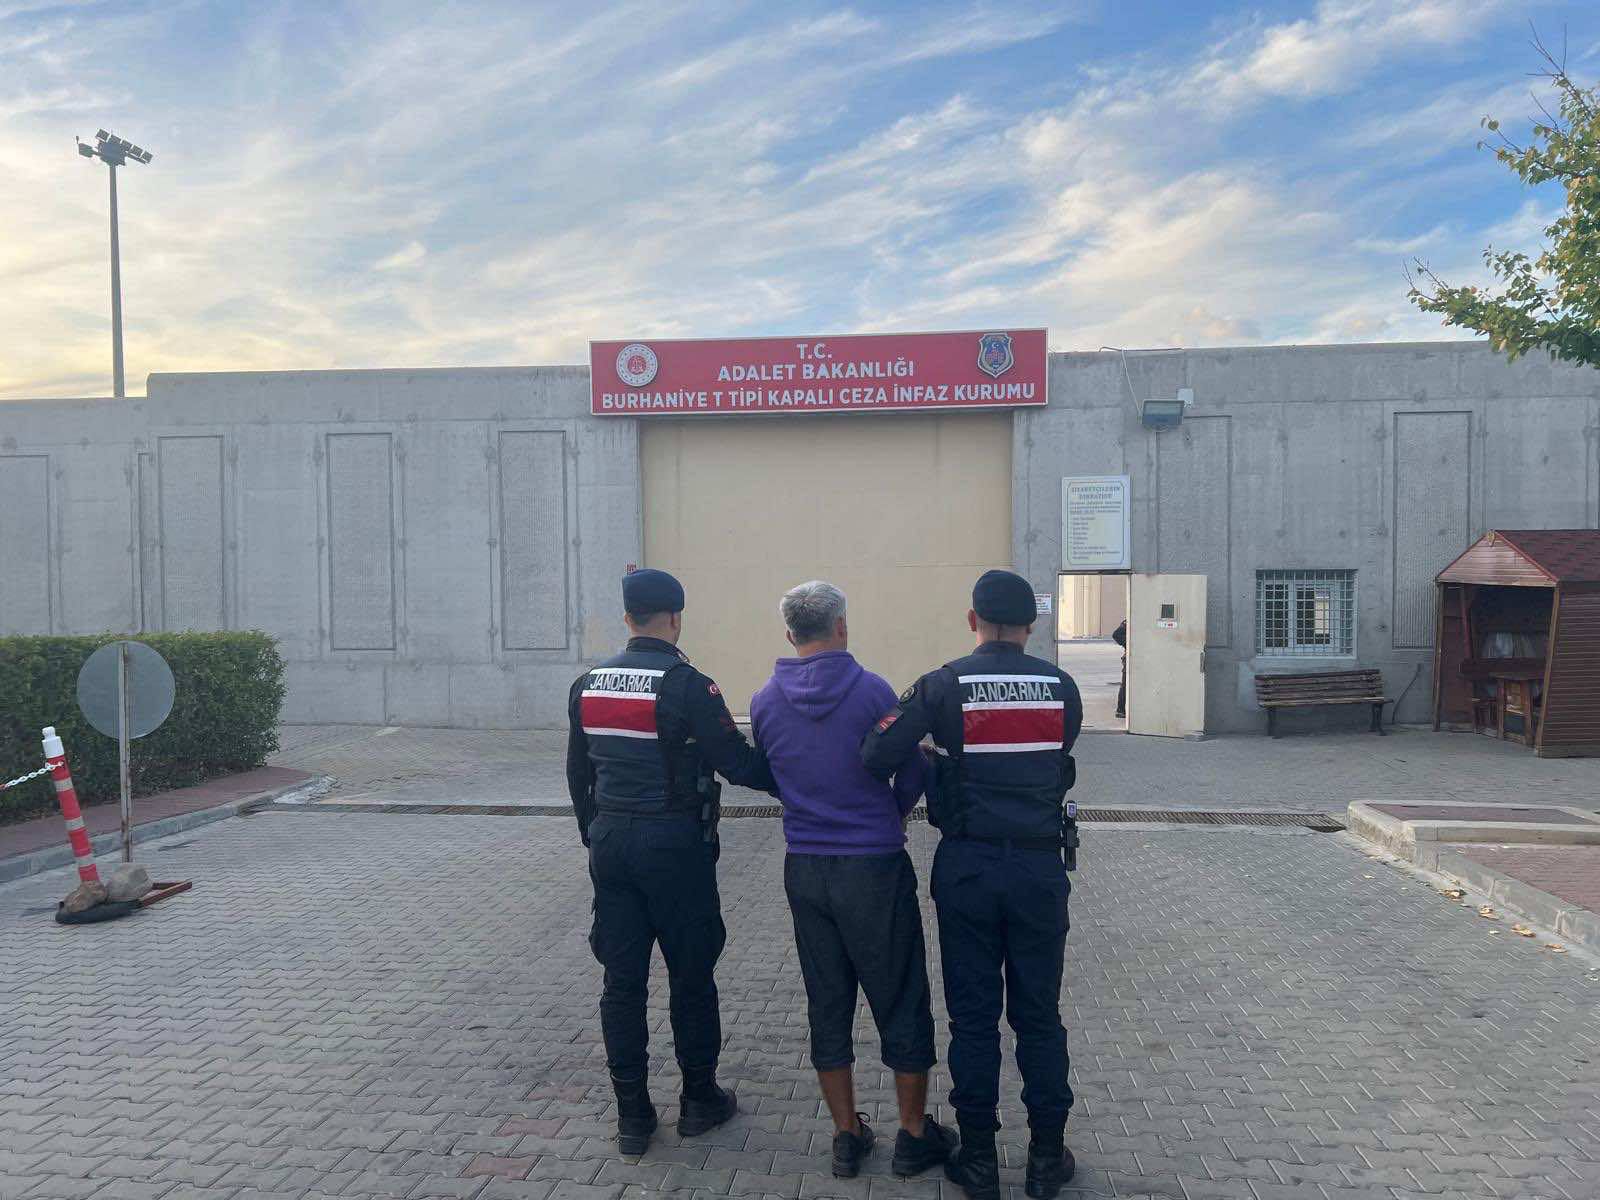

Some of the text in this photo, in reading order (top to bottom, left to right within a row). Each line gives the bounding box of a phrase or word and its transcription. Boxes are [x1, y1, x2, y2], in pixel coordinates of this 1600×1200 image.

[796, 342, 832, 360] T.C.
[717, 357, 914, 382] ADALET BAKANLIĞI
[602, 382, 1035, 409] BURHANİYE T TİPİ KAPALI CEZA İNFAZ KURUMU
[590, 673, 652, 692] JANDARMA
[968, 682, 1054, 702] JANDARMA
